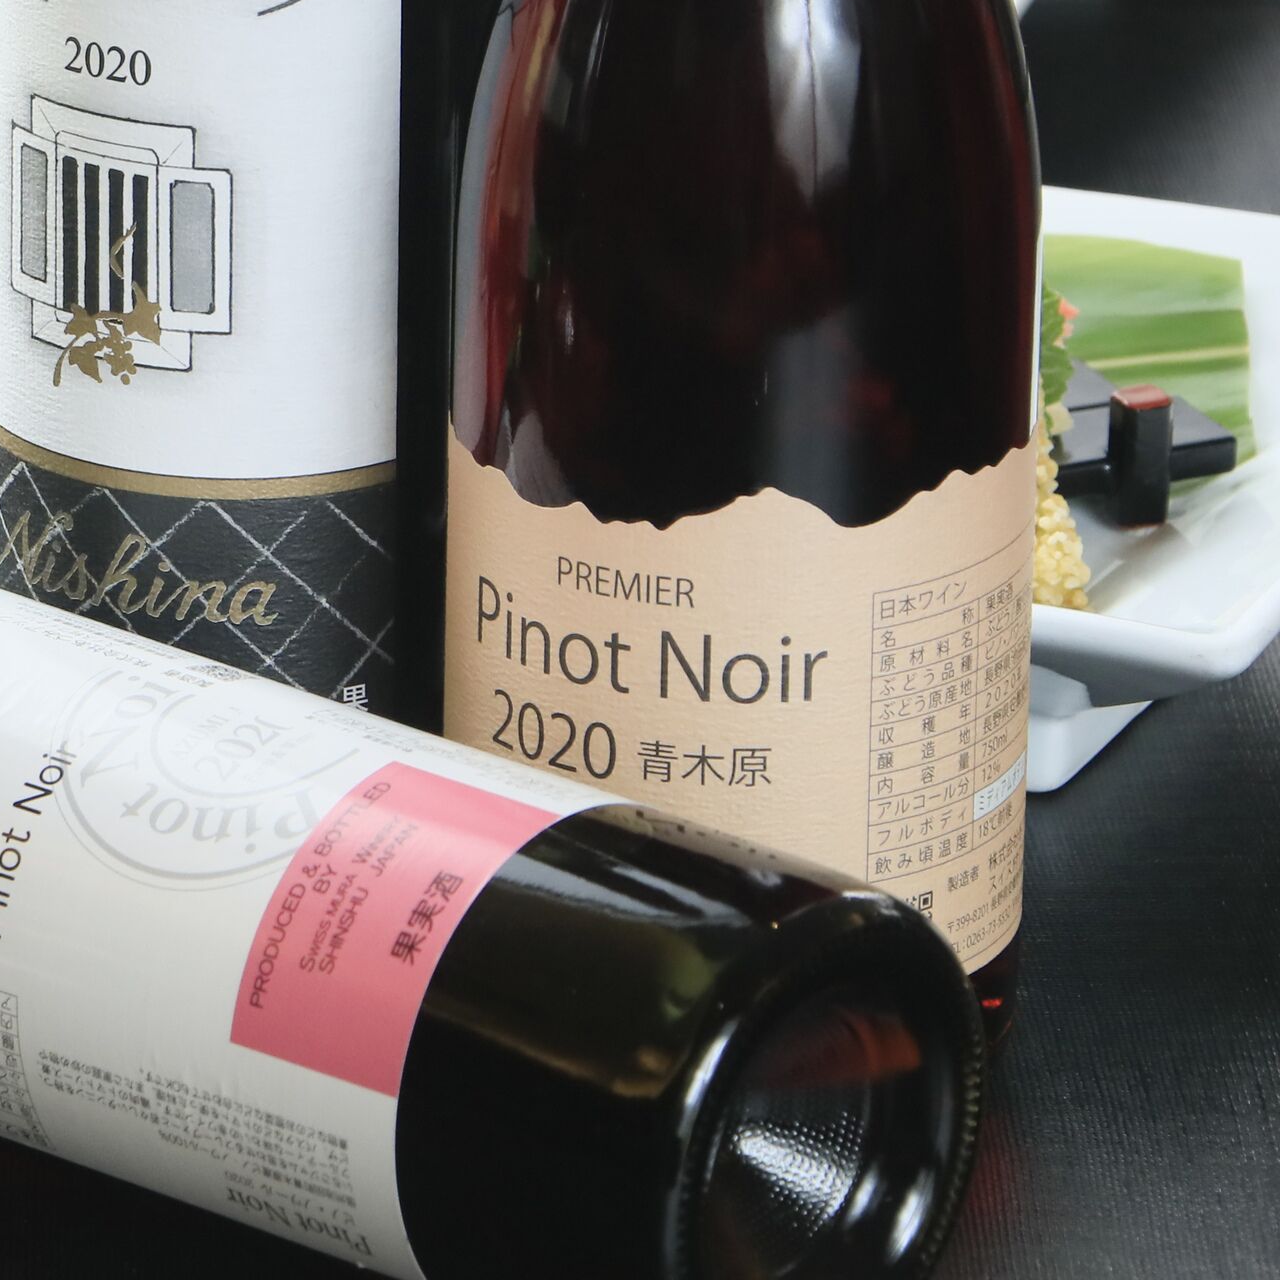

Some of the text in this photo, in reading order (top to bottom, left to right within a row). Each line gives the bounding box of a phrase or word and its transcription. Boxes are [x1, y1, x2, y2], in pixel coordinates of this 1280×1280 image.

[64, 36, 154, 86] 2020
[556, 556, 696, 610] PREMIER
[880, 581, 967, 620] 日本ワイン
[477, 575, 828, 704] Pinot Noir
[492, 688, 616, 780] 2020
[638, 740, 773, 788] 青木原
[13, 740, 78, 815] Noir
[877, 776, 970, 820] アルコール分
[249, 781, 391, 1009] PRODUCED & BOTTLED
[312, 864, 337, 894] BY
[318, 824, 419, 975] SHINSHU JAPAN
[390, 870, 464, 967] 果実酒
